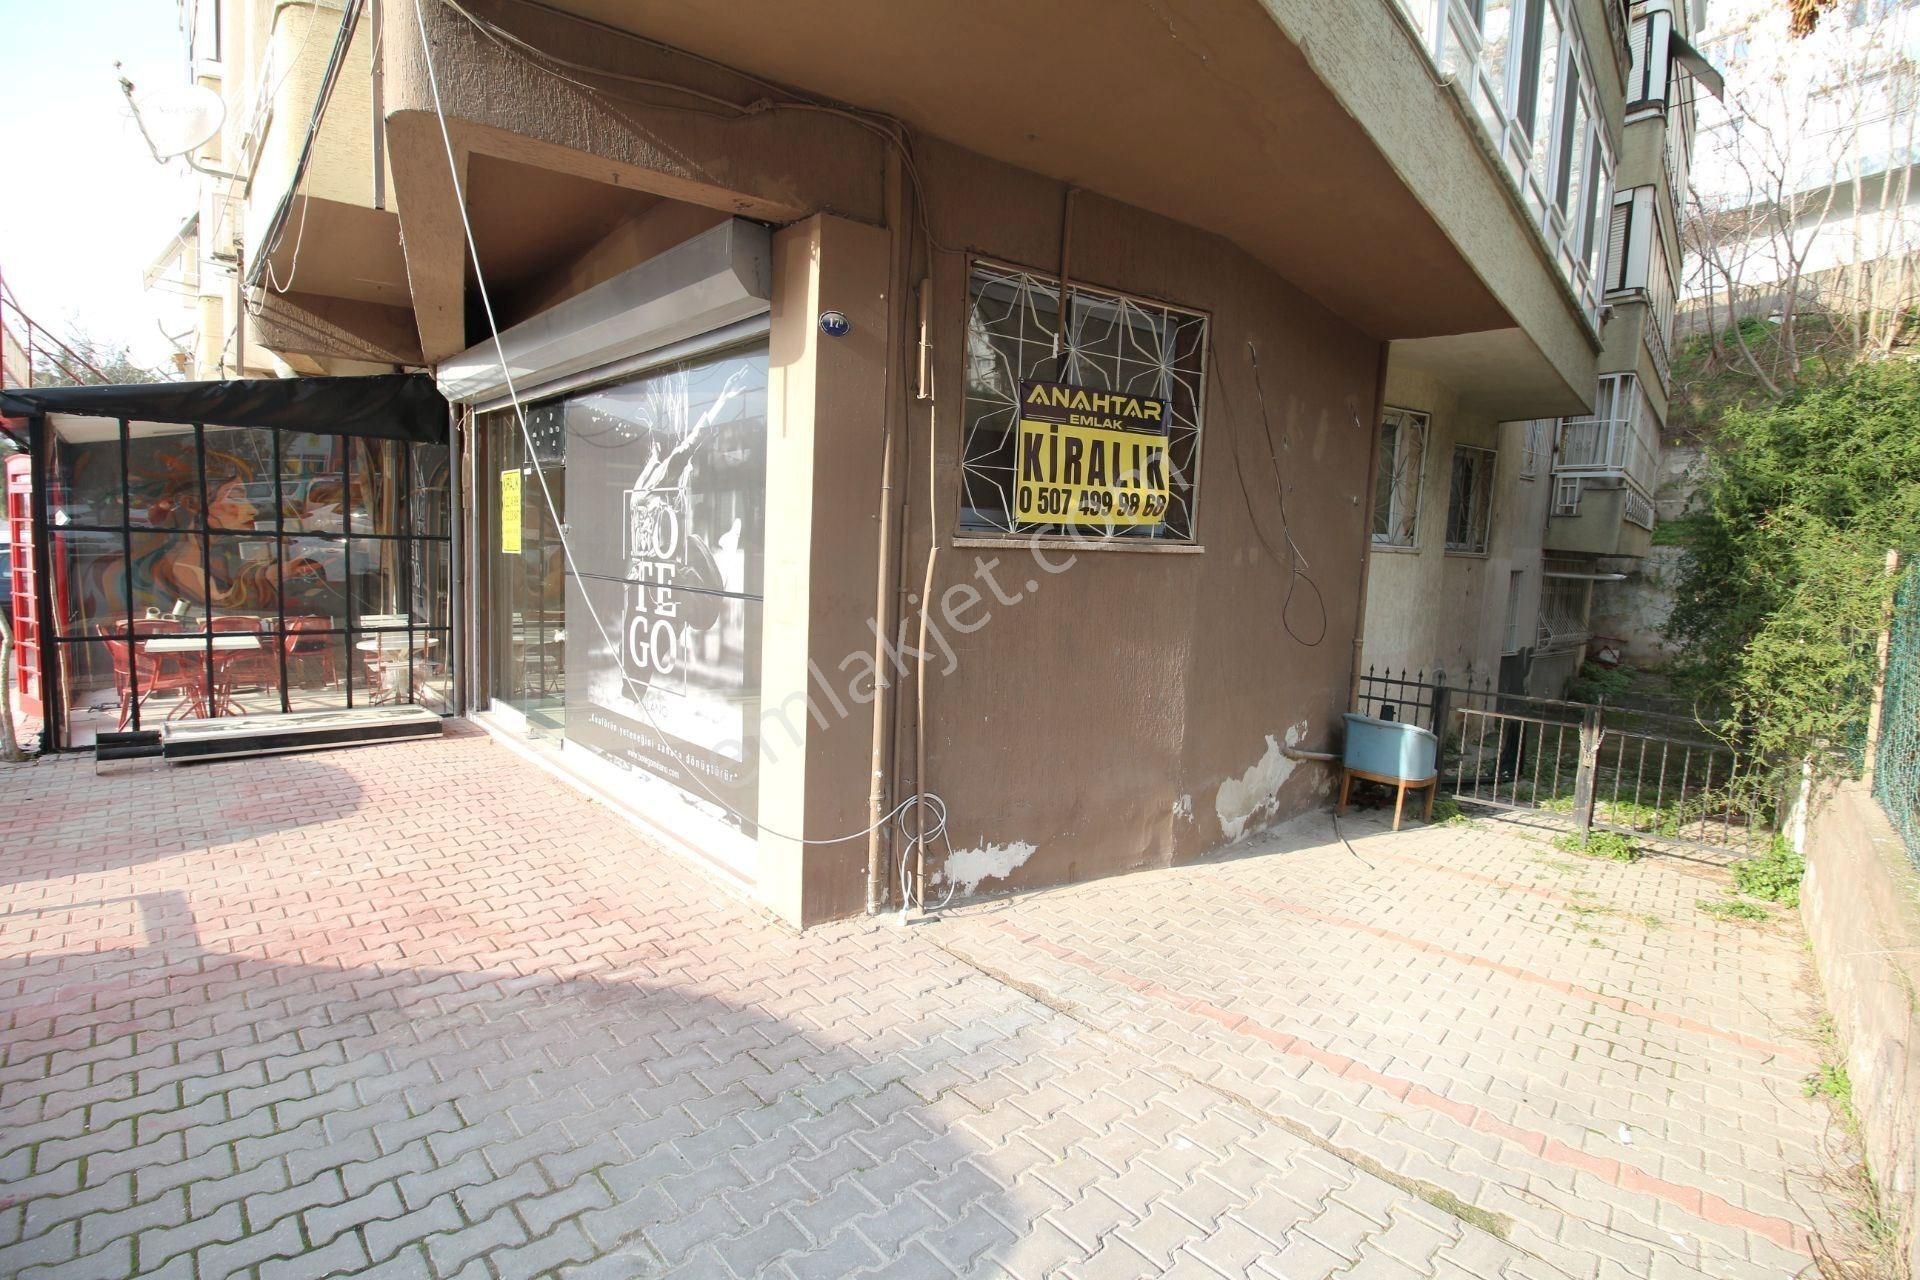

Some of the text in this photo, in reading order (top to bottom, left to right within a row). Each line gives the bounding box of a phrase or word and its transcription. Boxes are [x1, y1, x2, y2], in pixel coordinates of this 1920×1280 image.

[1027, 384, 1162, 421] ANAHTAR
[1069, 414, 1123, 430] EMLAK
[1023, 424, 1166, 490] KİRALIK
[1019, 485, 1032, 513] 0
[1037, 487, 1072, 515] 507
[1078, 489, 1113, 516] 499
[1116, 492, 1140, 517] 98
[635, 560, 677, 618] TE
[629, 615, 677, 675] GO
